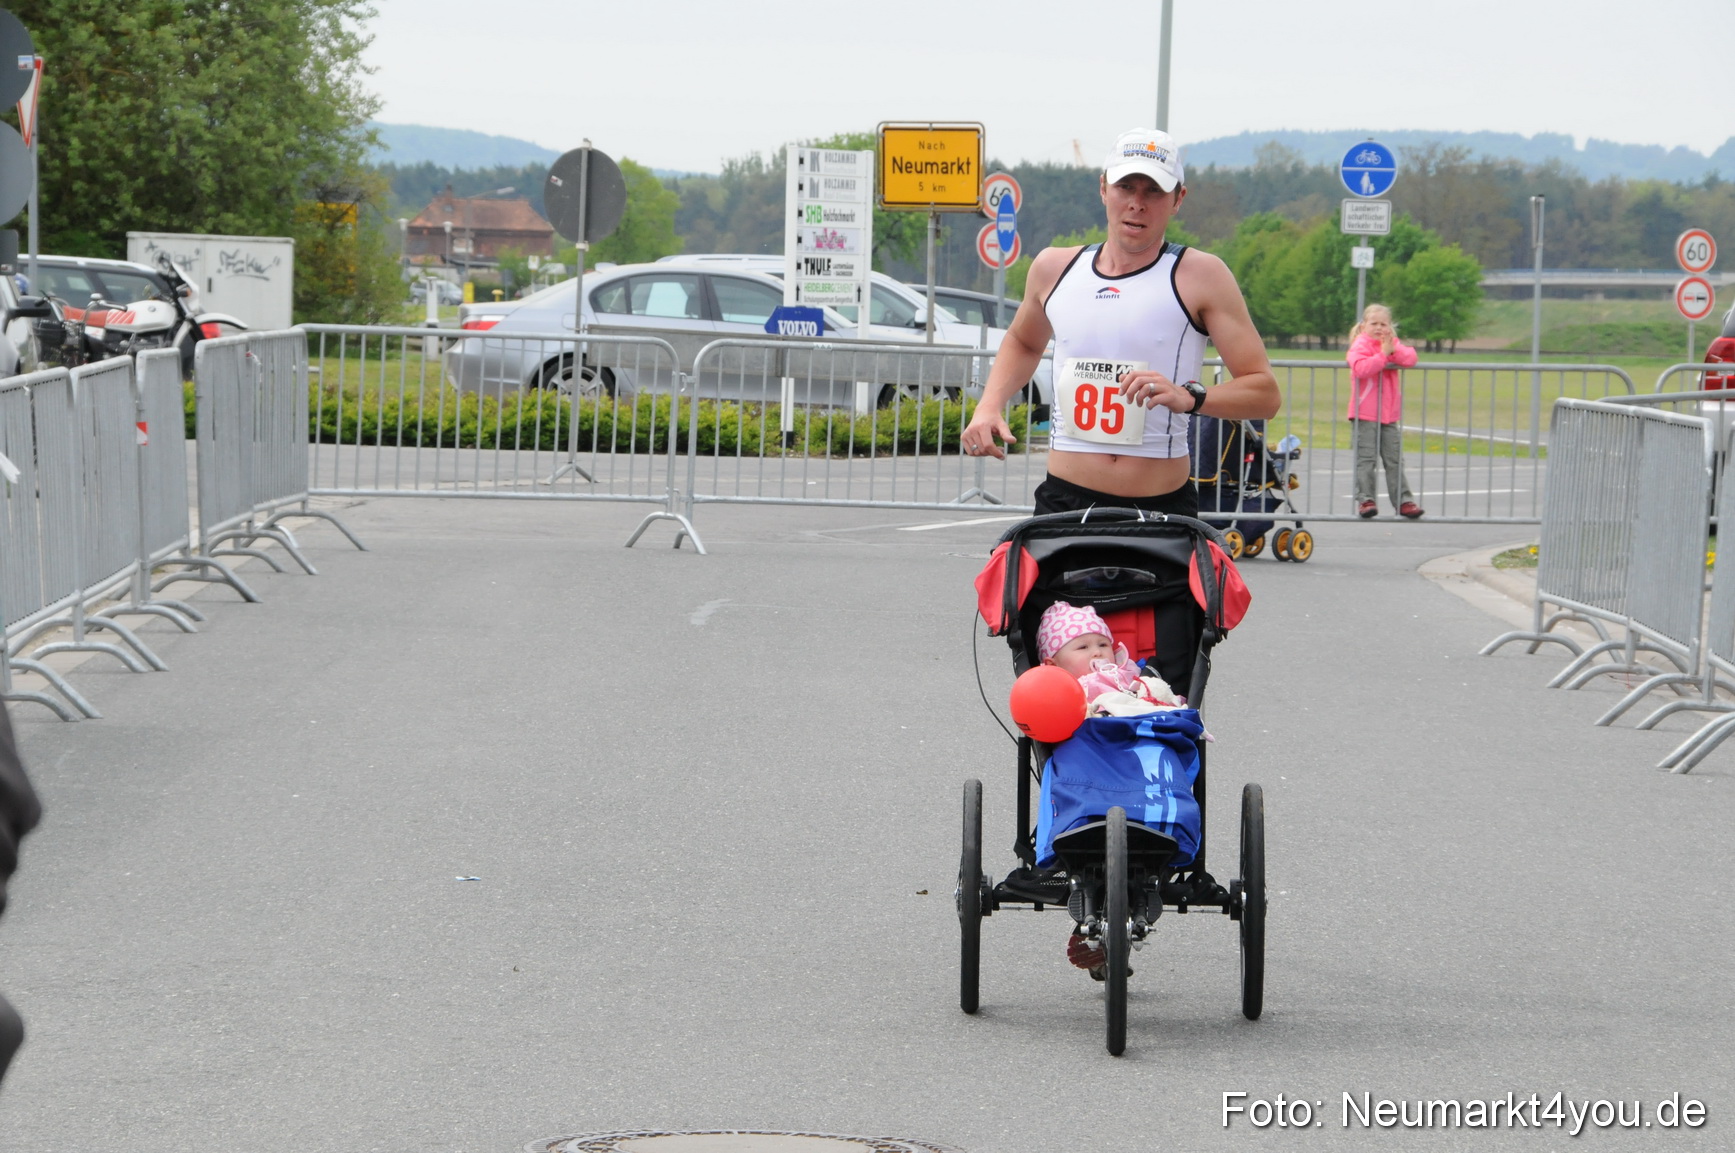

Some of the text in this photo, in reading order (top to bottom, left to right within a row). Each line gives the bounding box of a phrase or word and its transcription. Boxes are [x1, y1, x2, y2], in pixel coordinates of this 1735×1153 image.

[918, 141, 946, 150] Nach
[824, 152, 857, 164] HOLZAMMER
[892, 156, 971, 175] Neumarkt
[824, 178, 857, 190] HOLZAMMER
[918, 182, 947, 192] 5 km
[805, 205, 823, 224] SHB
[1687, 242, 1707, 261] 60
[804, 257, 832, 276] THULE
[778, 320, 818, 336] VOLVO
[1075, 362, 1113, 373] MEYER
[1074, 371, 1113, 381] WERBUNG
[1073, 383, 1125, 435] 85
